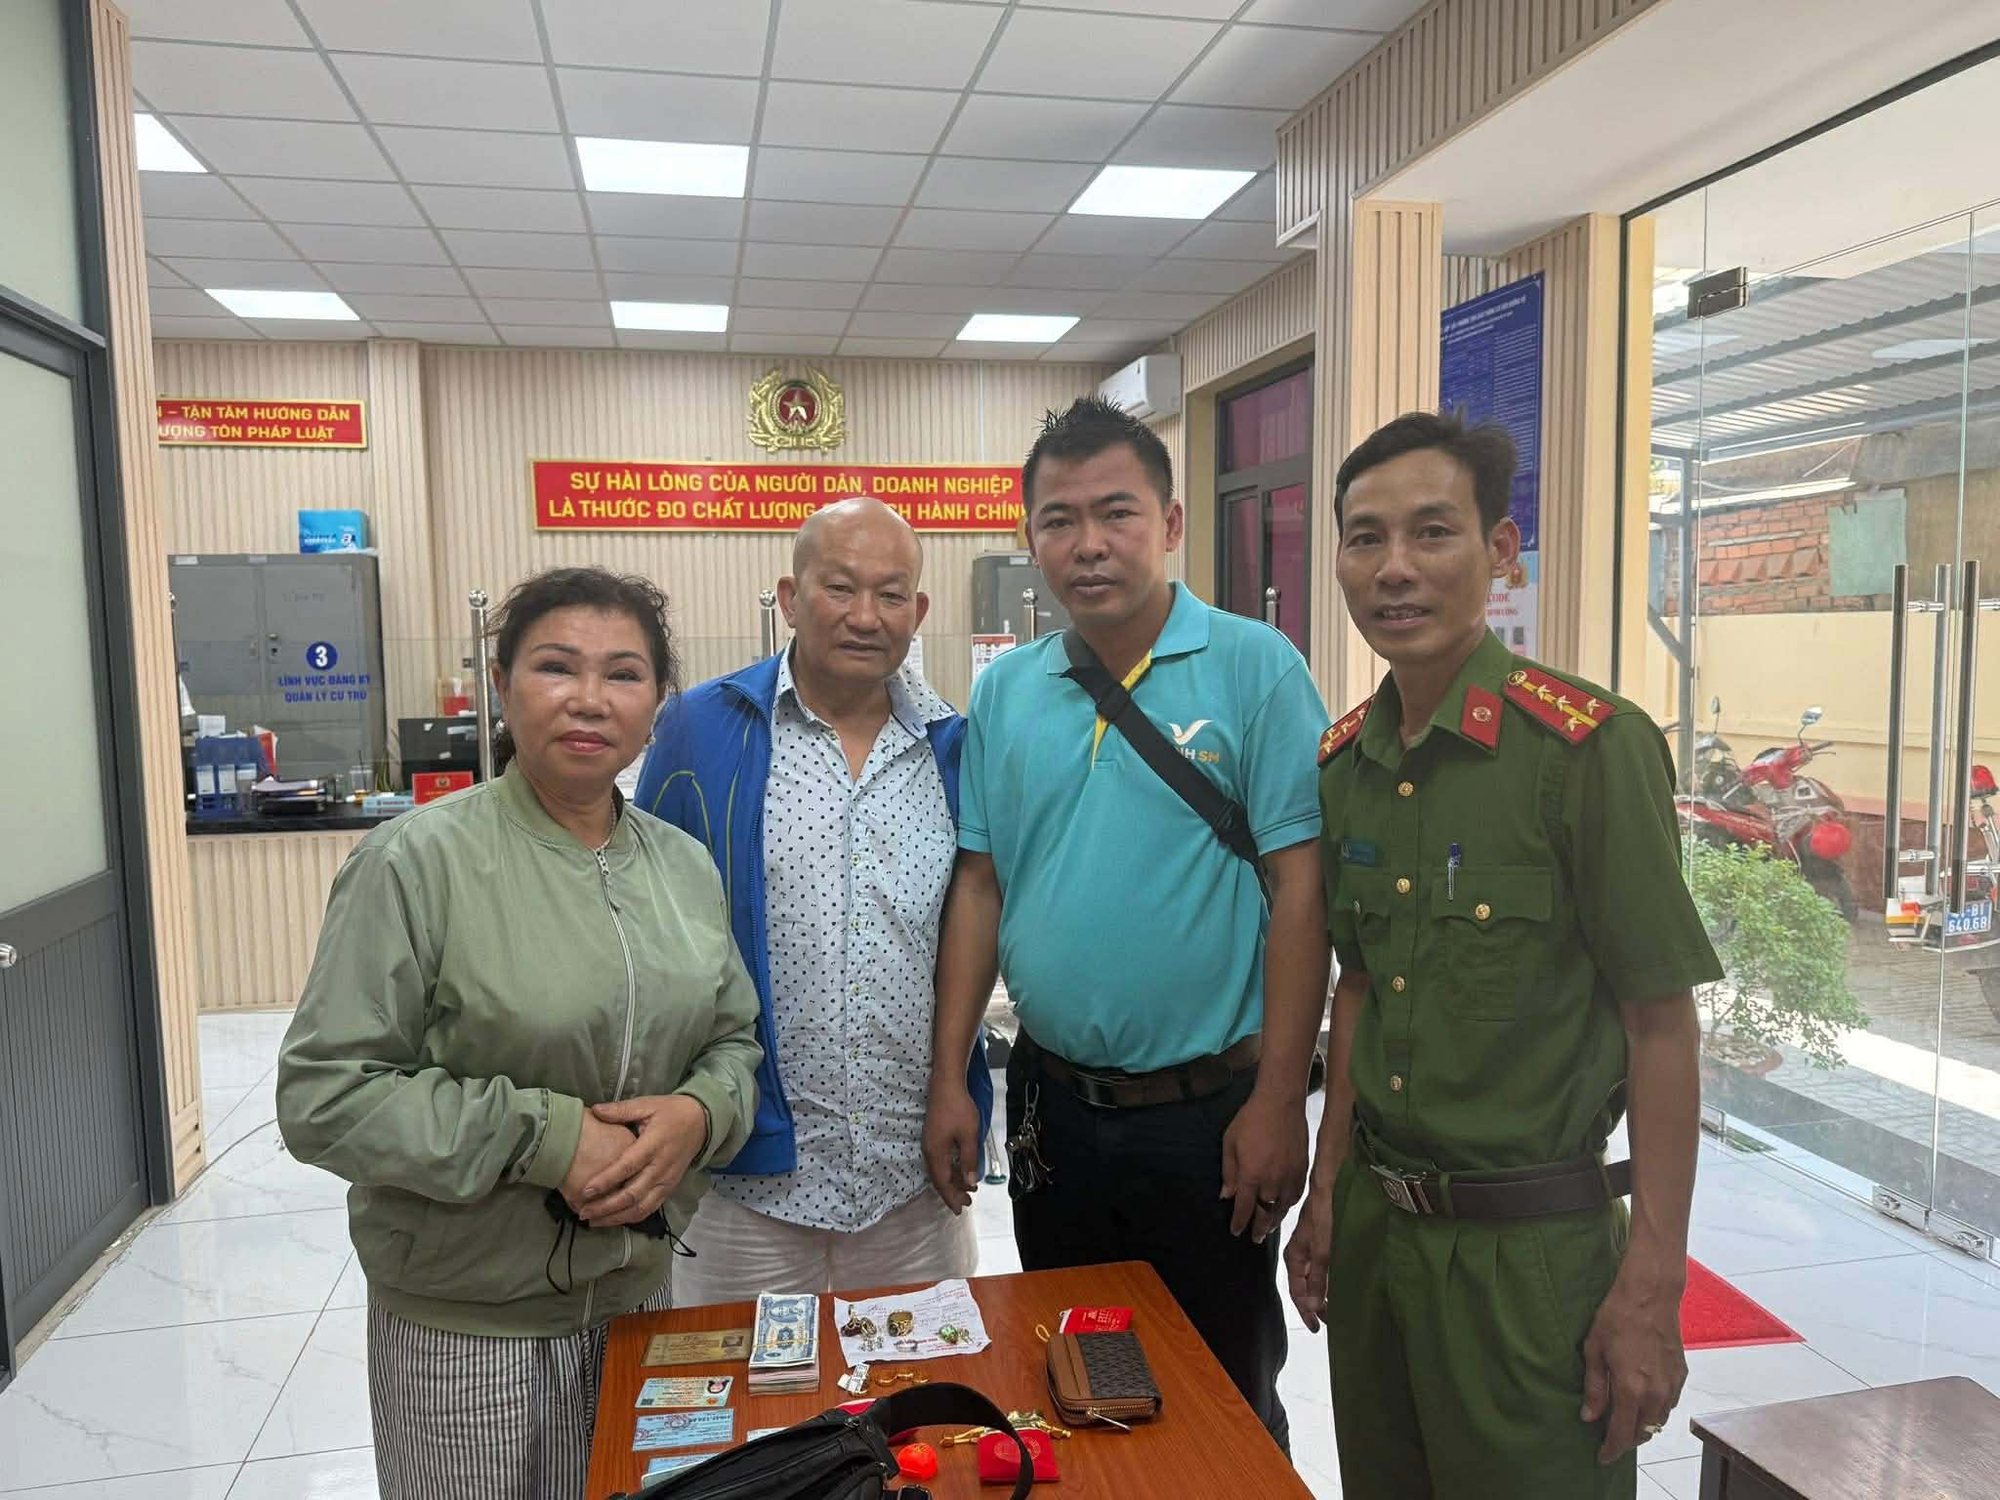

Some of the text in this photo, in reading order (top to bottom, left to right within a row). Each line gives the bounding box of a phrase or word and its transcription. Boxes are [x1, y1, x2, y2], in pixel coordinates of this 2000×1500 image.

[182, 405, 212, 421] TẬN
[216, 405, 248, 419] TÂM
[253, 405, 313, 421] HƯỚNG
[317, 405, 350, 421] DẪN
[158, 424, 335, 442] ƯỢNG TÔN PHÁP LUẬT
[570, 469, 1014, 498] SỰ HÀI LÒNG CỦA NGƯỜI DÂN, DOANH NGHIỆP
[549, 496, 575, 517] LÀ
[579, 498, 650, 518] THƯỚC
[656, 500, 686, 519] ĐO
[693, 497, 744, 519] CHẤT
[750, 499, 815, 522] LƯỢNG
[918, 500, 969, 520] HÀNH
[315, 645, 329, 668] 3
